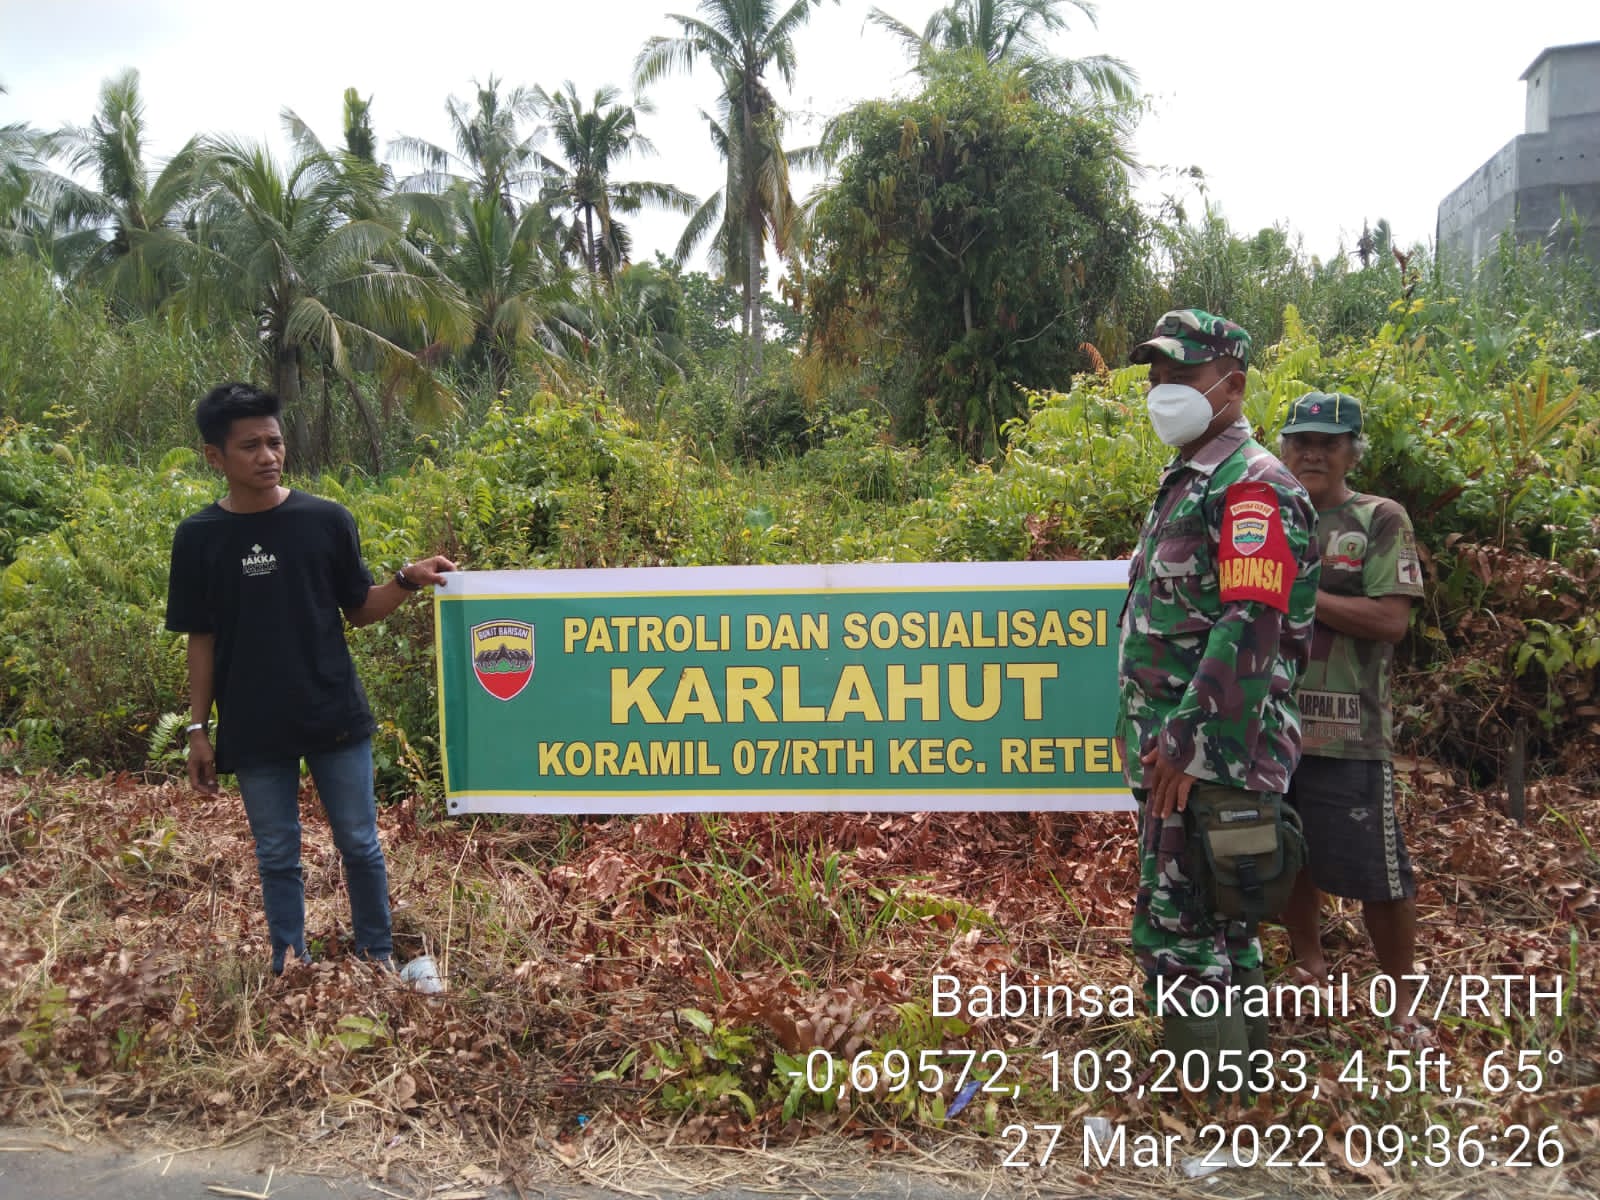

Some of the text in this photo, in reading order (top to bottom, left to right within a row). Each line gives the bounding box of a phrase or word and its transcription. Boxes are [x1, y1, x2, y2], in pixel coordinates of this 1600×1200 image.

[563, 609, 1108, 654] PATROLI DAN SOSIALISASI
[610, 662, 1059, 725] KARLAHUT
[538, 740, 721, 777] KORAMIL
[732, 738, 875, 776] 07/RTH
[888, 737, 987, 775] KEC.
